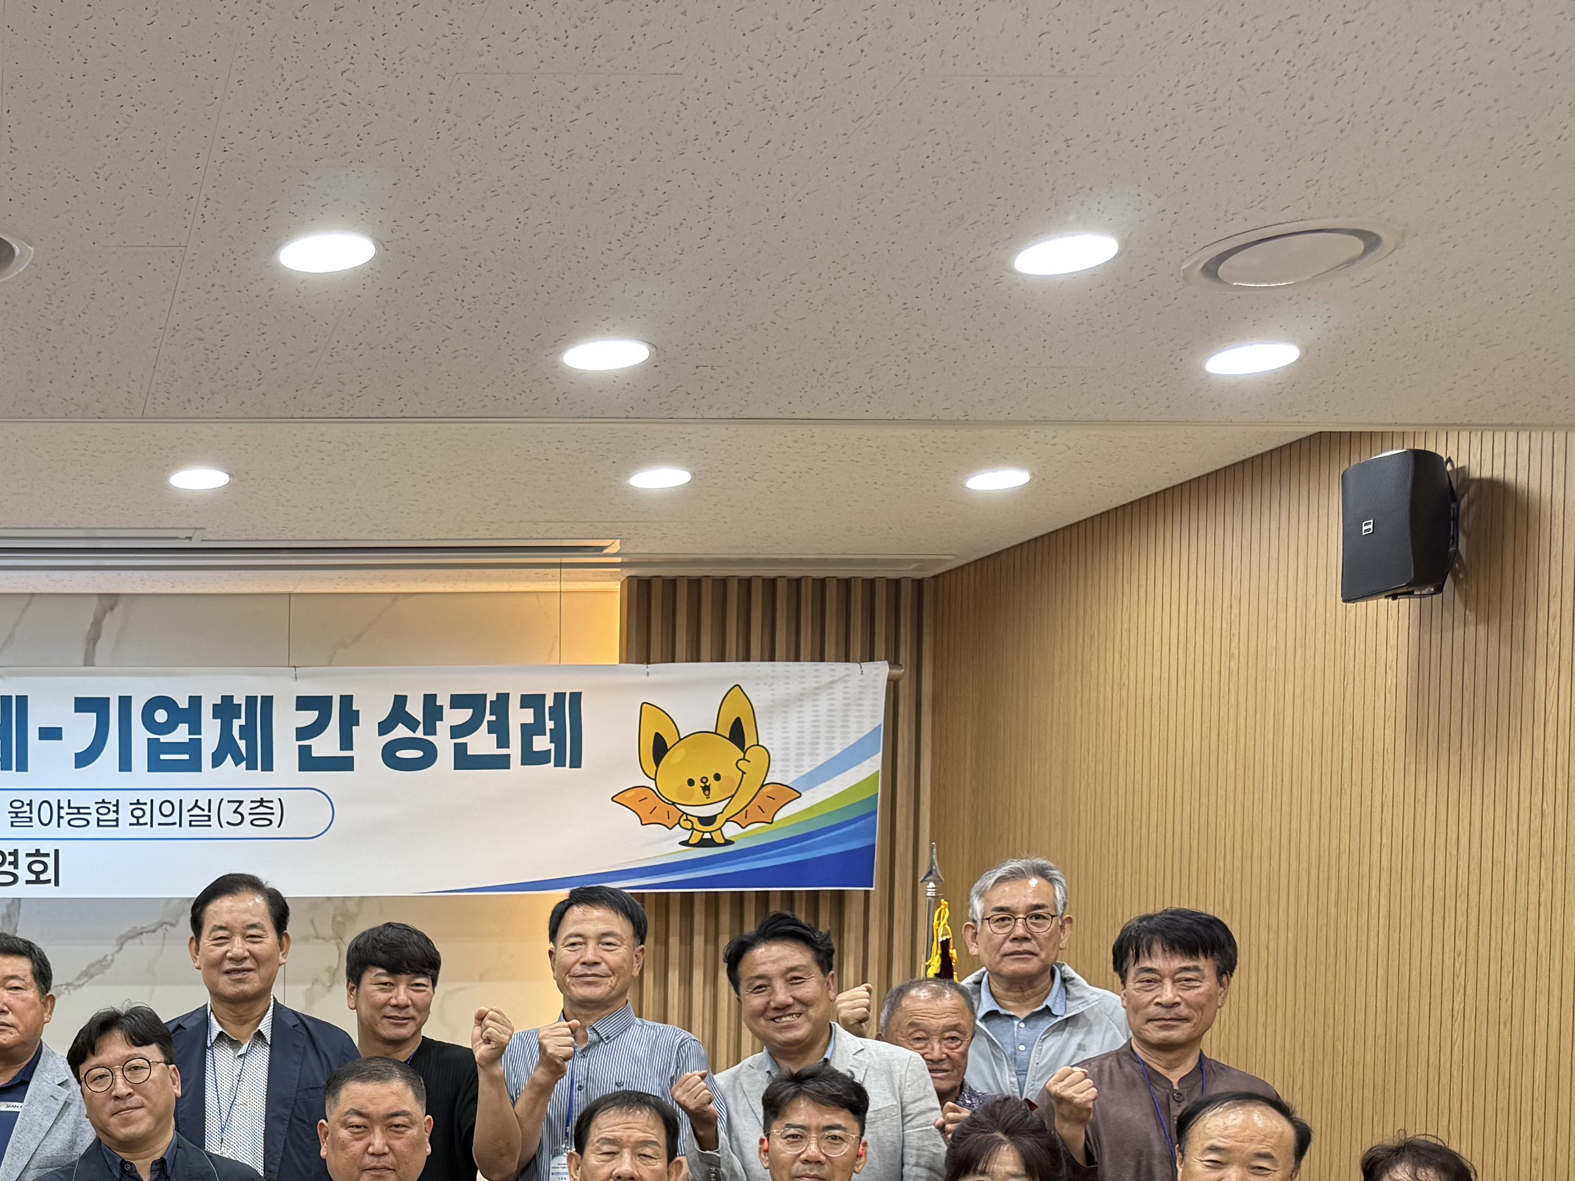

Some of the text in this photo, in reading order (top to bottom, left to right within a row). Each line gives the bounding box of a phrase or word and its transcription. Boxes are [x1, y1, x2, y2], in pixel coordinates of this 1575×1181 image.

[294, 694, 361, 773] 간
[377, 691, 583, 772] 상견례
[7, 798, 120, 829] 월야농협
[128, 796, 285, 829] 회의실(3층)
